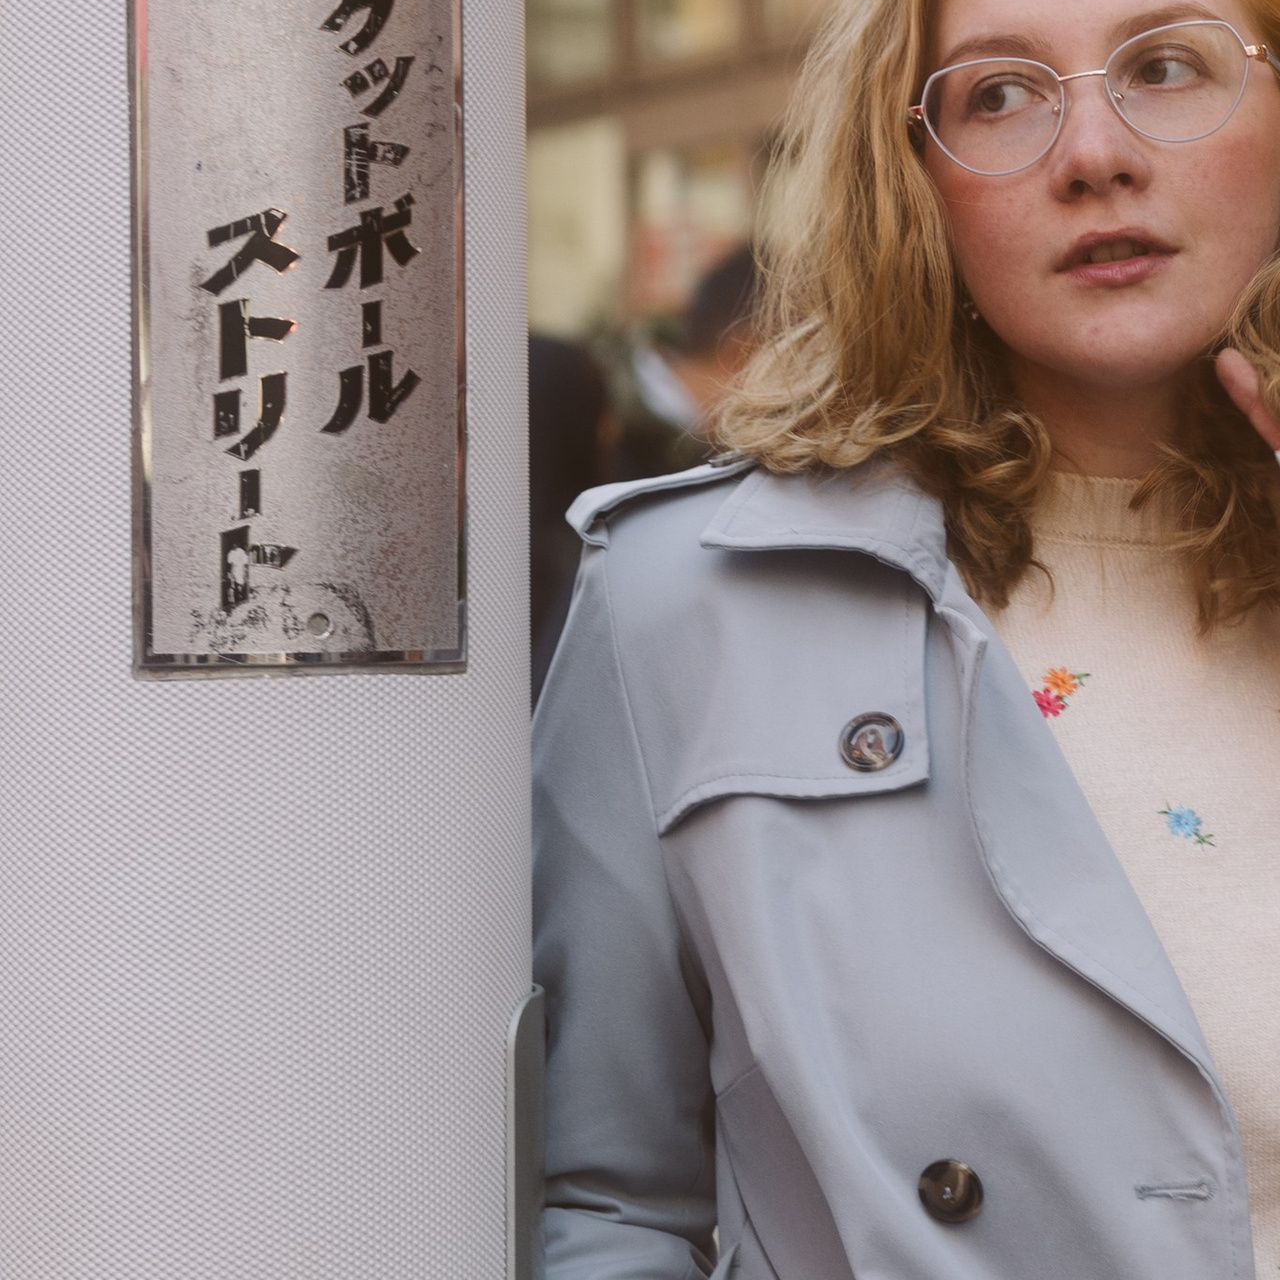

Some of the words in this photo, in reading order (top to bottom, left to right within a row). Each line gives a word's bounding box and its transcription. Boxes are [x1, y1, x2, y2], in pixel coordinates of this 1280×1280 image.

[200, 208, 302, 615] ストリート
